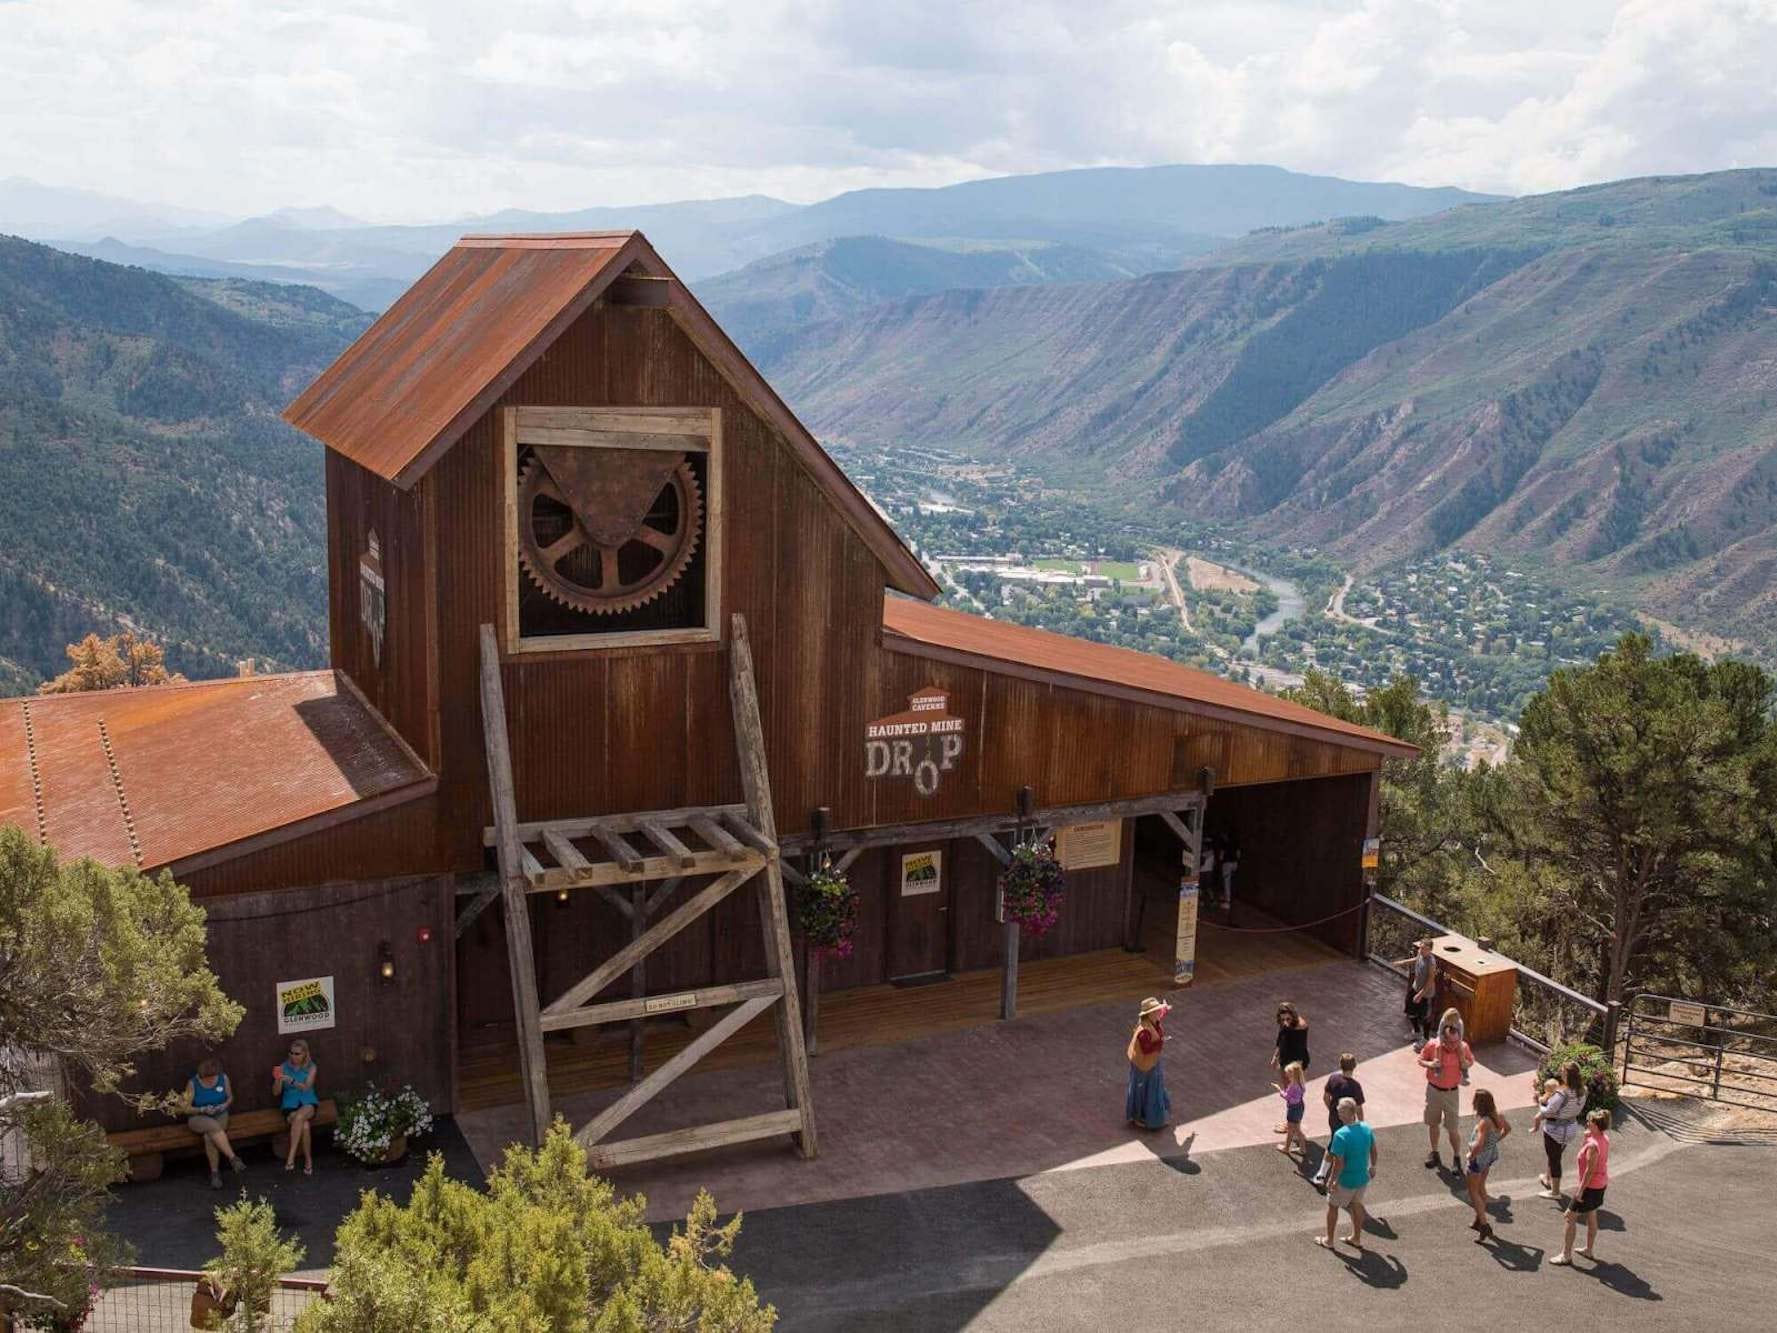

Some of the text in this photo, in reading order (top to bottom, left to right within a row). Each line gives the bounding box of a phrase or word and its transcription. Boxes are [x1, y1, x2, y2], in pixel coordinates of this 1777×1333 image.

[911, 702, 945, 712] CAVERNS
[912, 696, 946, 704] GLENWOOD
[868, 719, 962, 737] HAUNTED MINE
[864, 733, 963, 795] DROP
